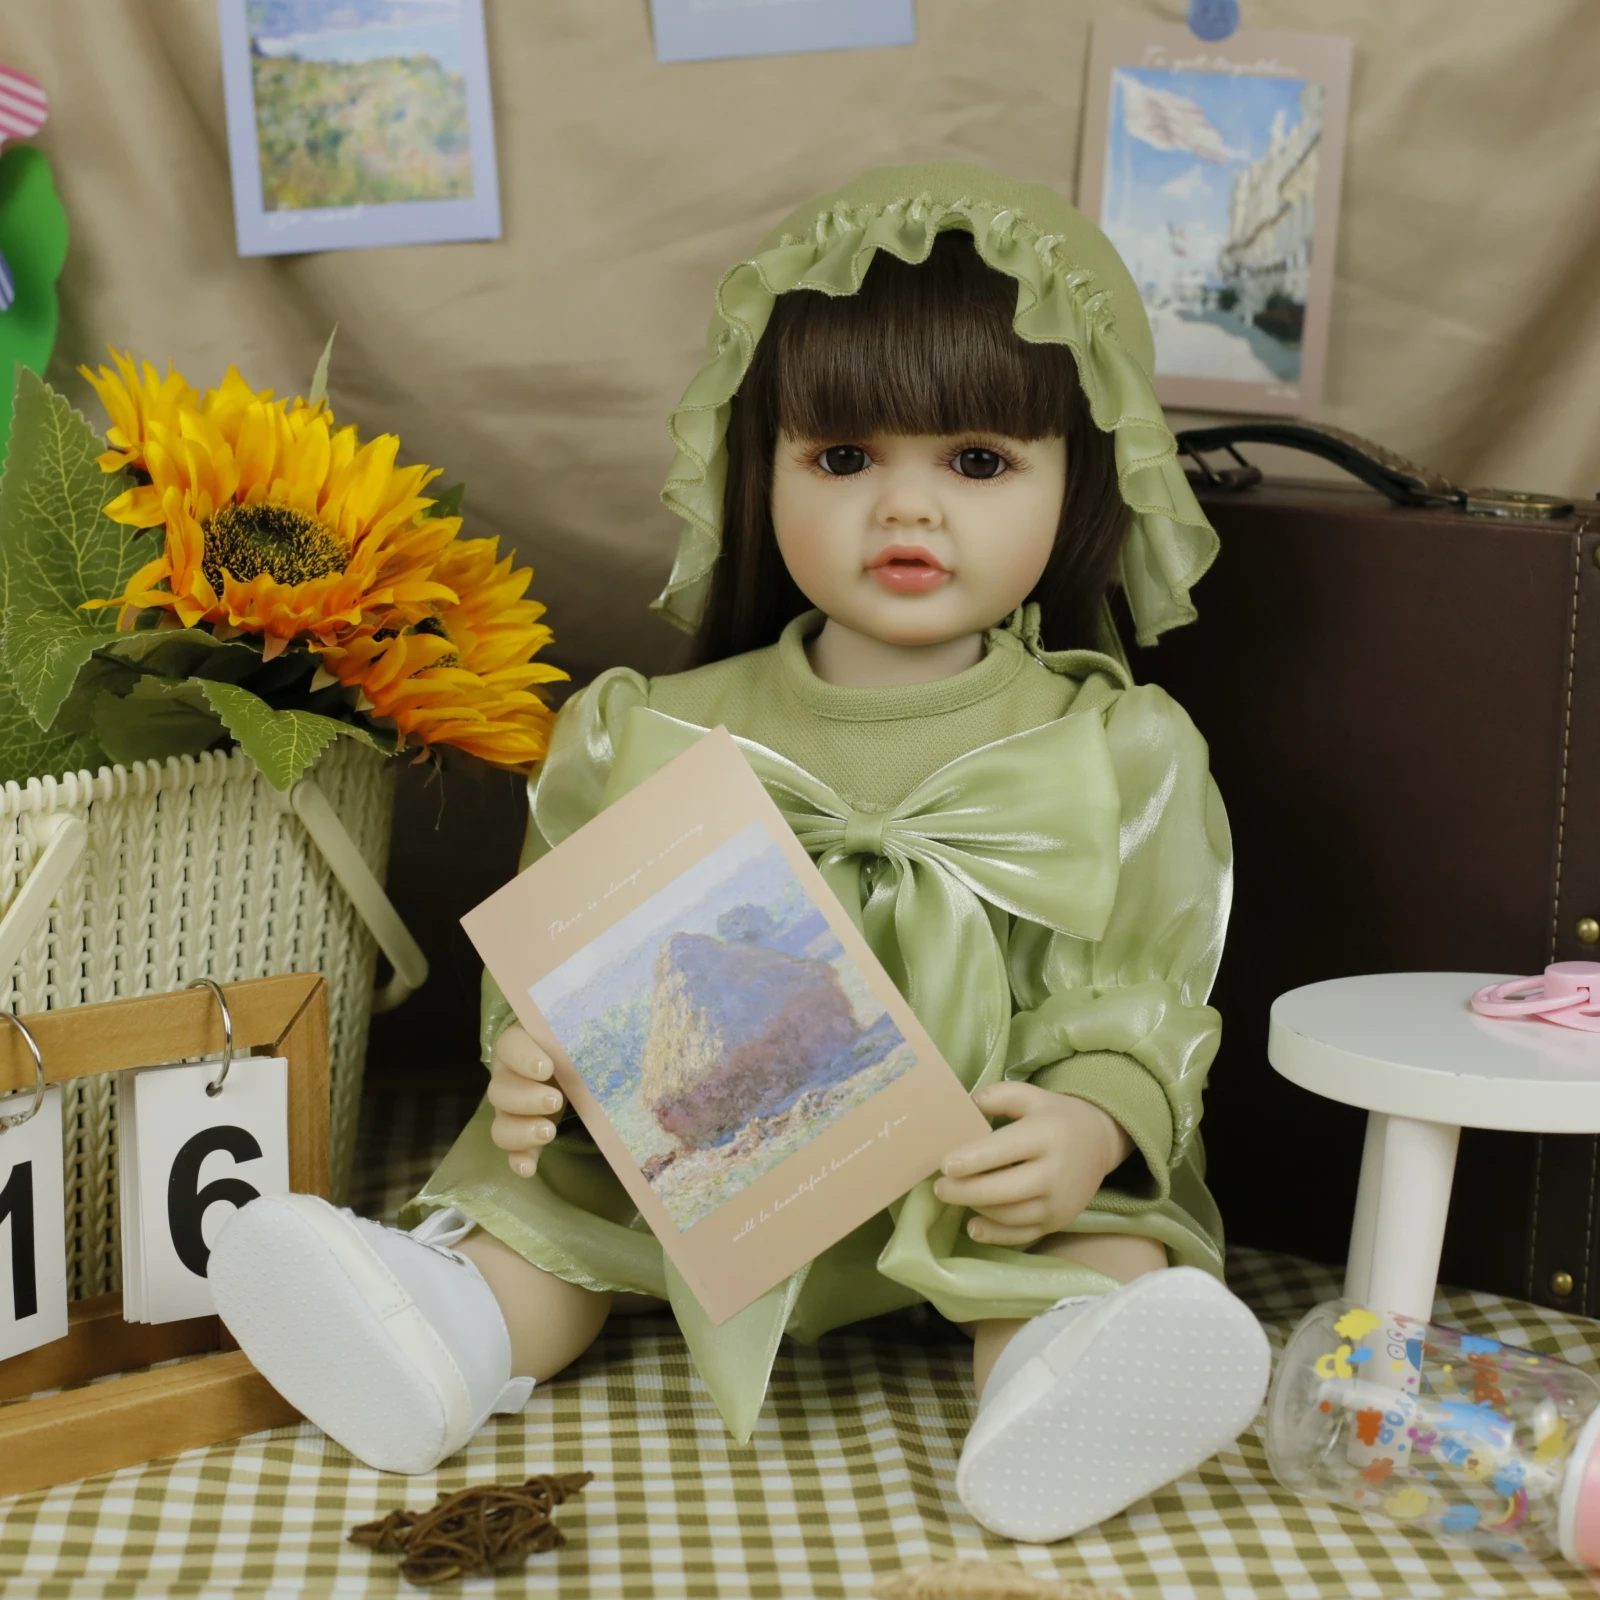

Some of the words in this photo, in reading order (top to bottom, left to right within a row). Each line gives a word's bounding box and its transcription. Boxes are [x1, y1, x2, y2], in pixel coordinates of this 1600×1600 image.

[547, 911, 584, 941] There
[587, 900, 600, 911] is
[602, 867, 643, 900] always
[0, 1160, 38, 1321] 1
[167, 1125, 263, 1279] 6
[732, 1216, 757, 1243] will
[759, 1209, 772, 1222] be
[774, 1165, 829, 1212] beautiful
[830, 1138, 875, 1172] because
[876, 1119, 890, 1139] of
